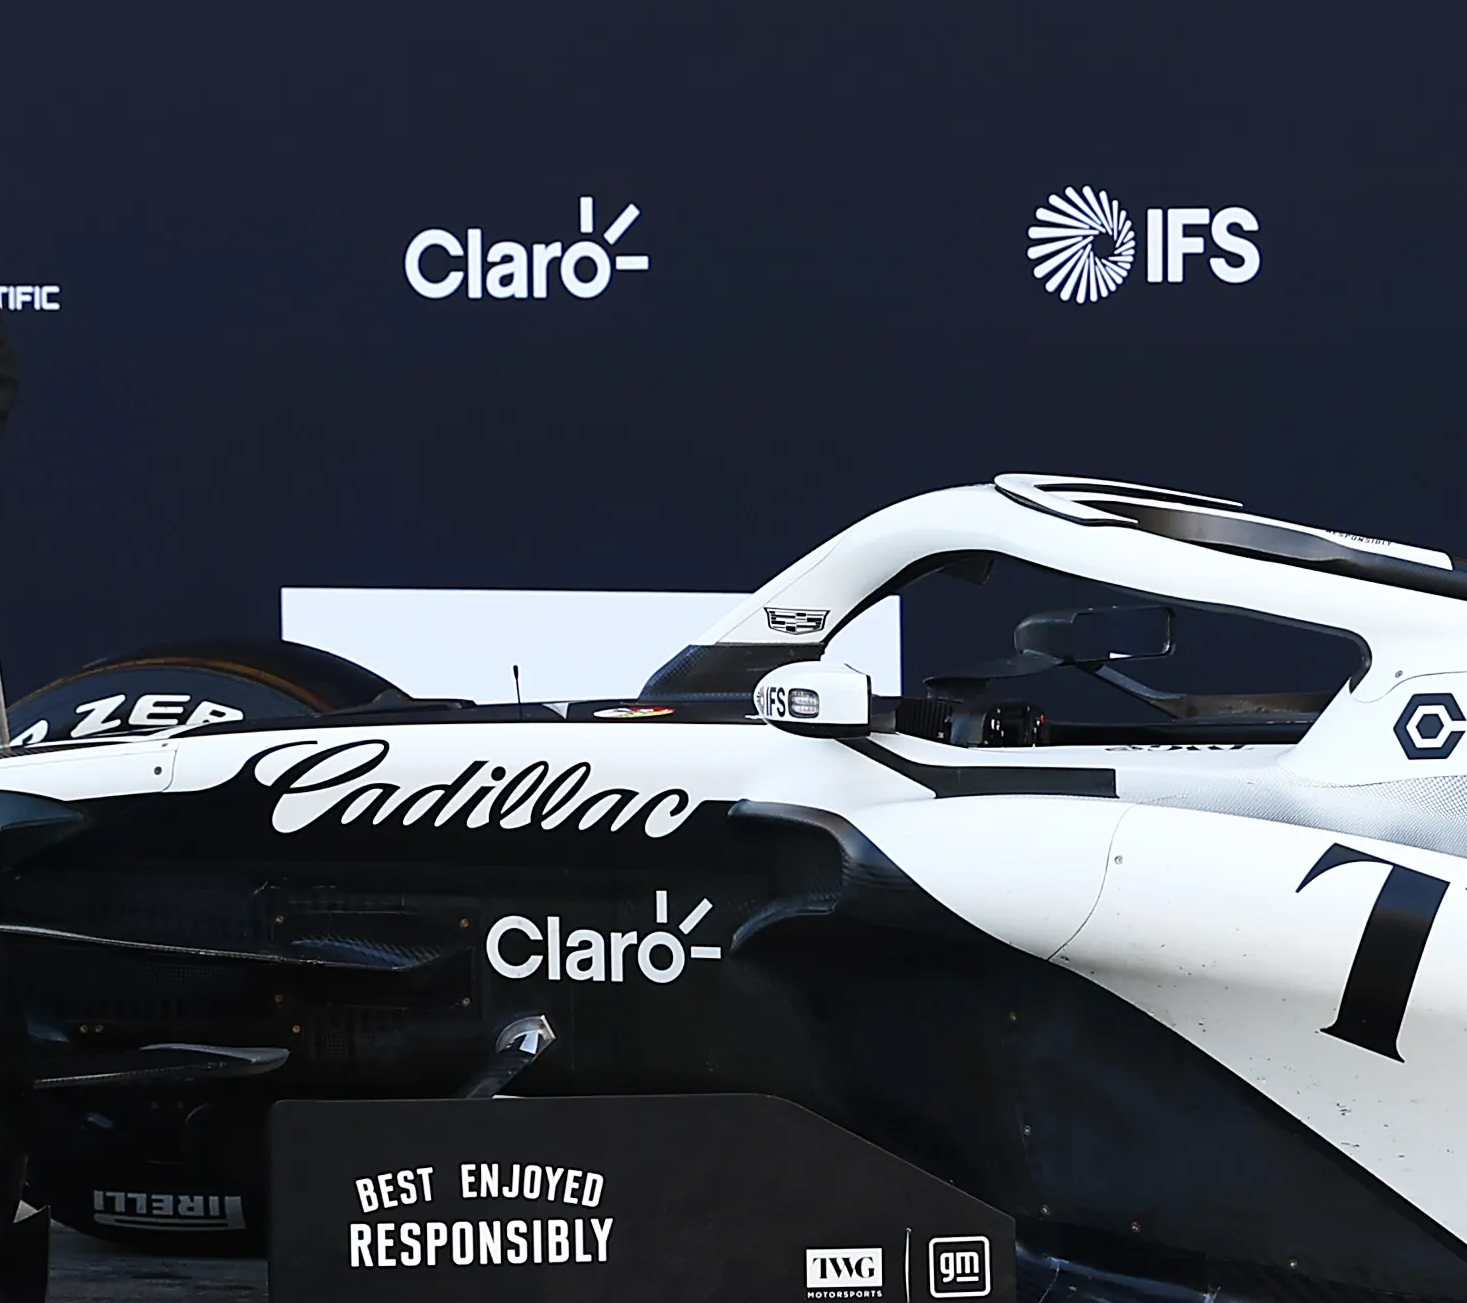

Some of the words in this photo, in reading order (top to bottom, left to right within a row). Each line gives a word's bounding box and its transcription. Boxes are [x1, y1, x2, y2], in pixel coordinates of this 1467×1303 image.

[404, 226, 614, 299] Claro
[1146, 206, 1262, 284] IFS
[70, 694, 244, 738] ZER
[766, 687, 786, 717] IFS
[252, 739, 707, 838] Cadillac
[486, 911, 685, 983] Claro
[355, 1166, 434, 1213] BEST
[461, 1163, 604, 1208] ENJOYED
[350, 1218, 614, 1268] RESPONSIBLY
[813, 1256, 875, 1280] TWG
[939, 1251, 980, 1283] gm
[807, 1290, 883, 1300] MOTORSPORTS
